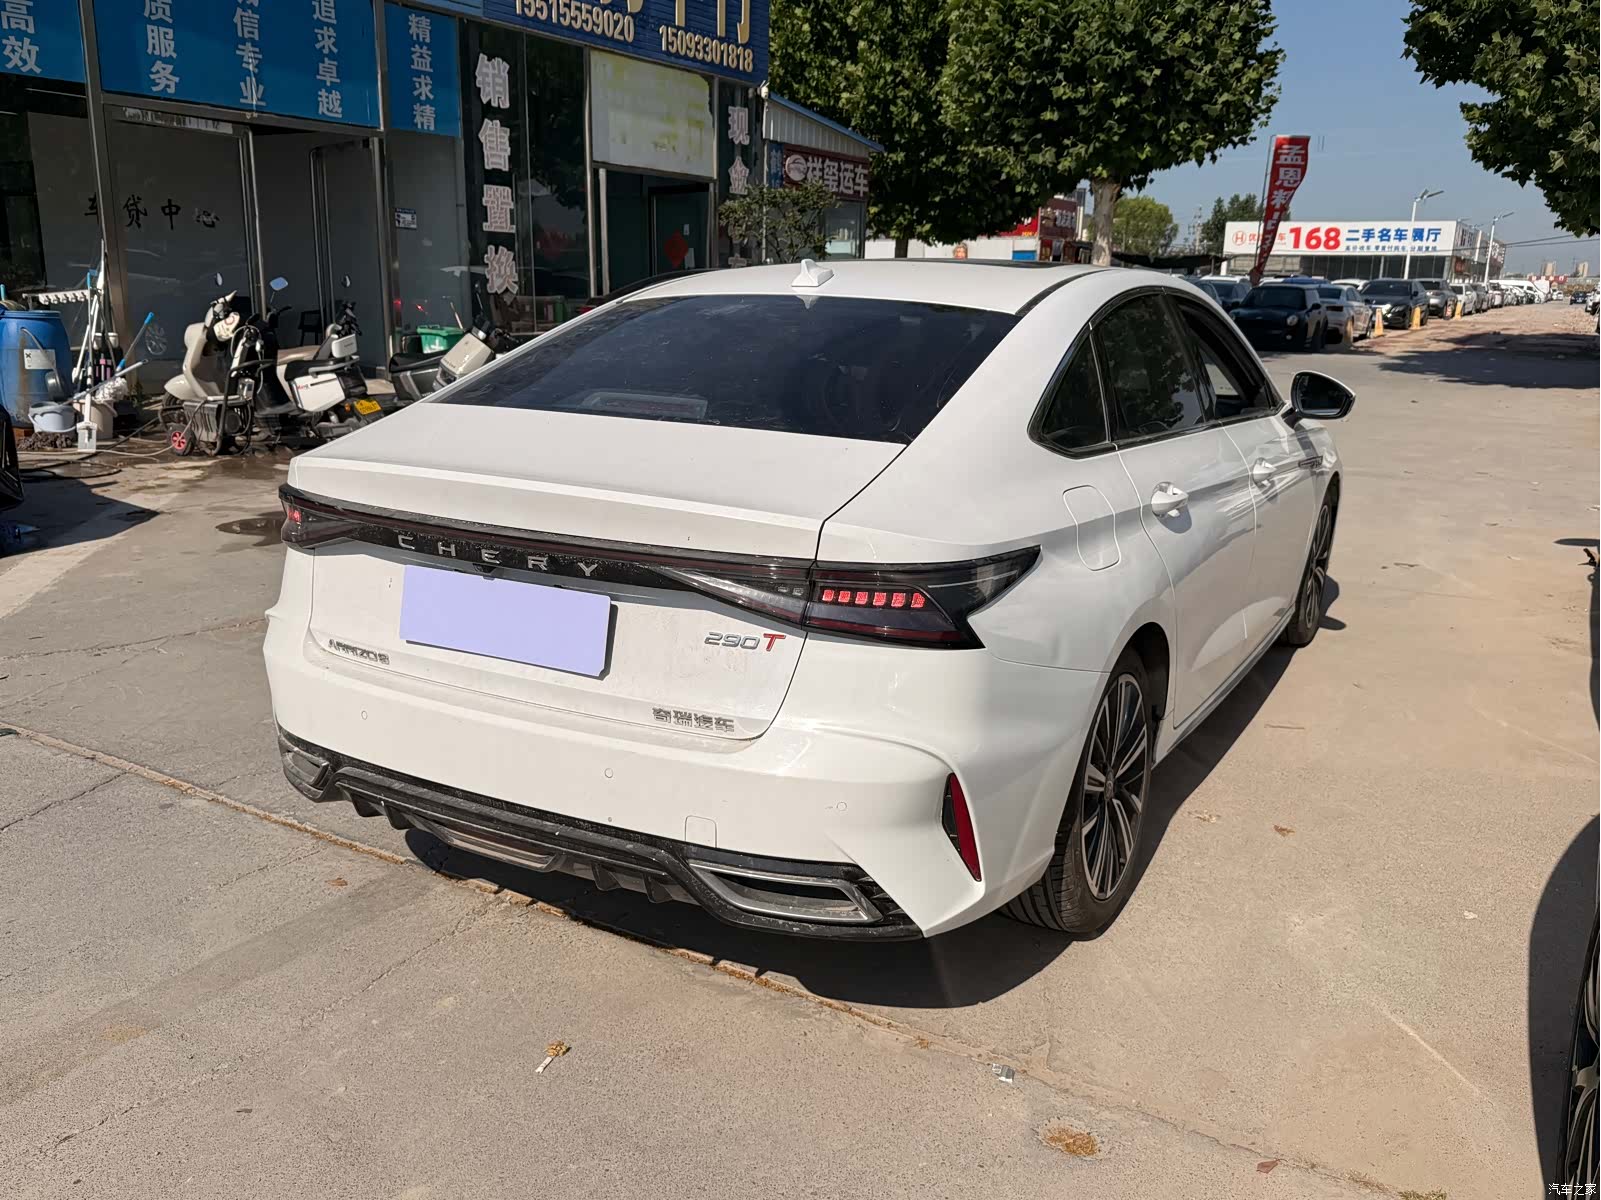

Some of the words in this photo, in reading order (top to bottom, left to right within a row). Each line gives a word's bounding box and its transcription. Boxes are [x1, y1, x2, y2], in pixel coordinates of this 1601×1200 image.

[0, 0, 42, 74] 高效
[233, 0, 266, 106] 信专业
[312, 0, 342, 118] 追求卓越
[408, 13, 436, 131] 精益求精
[660, 25, 753, 72] 15093301818
[475, 53, 518, 295] 销售置换
[1289, 226, 1341, 250] 168
[398, 534, 598, 577] CHERY
[652, 707, 735, 733] 奇瑞汽车
